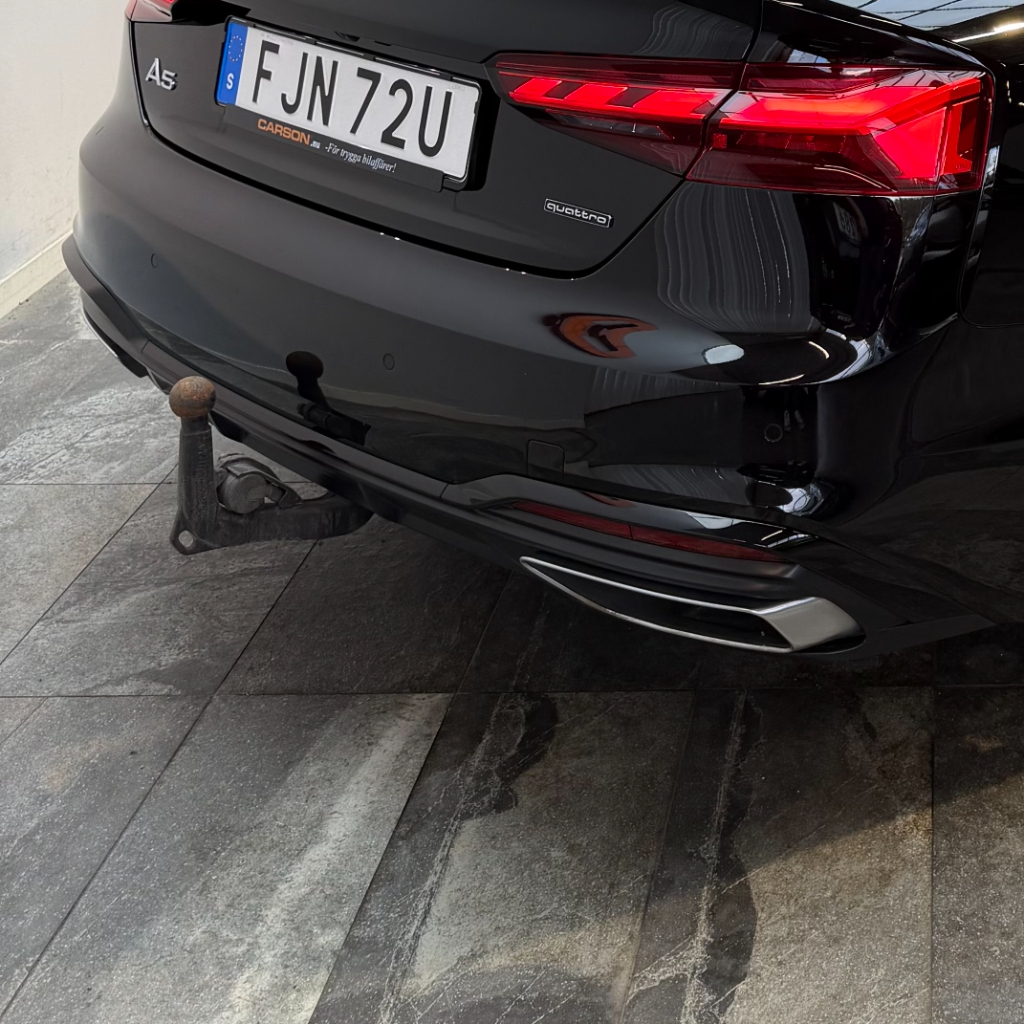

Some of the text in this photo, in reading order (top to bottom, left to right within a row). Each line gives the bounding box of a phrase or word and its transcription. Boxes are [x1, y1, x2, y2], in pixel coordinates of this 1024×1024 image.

[145, 57, 177, 91] A5
[225, 39, 453, 158] S FJN 72U
[340, 147, 361, 163] trygga
[362, 153, 397, 173] bilaffärer!
[546, 202, 607, 224] quattro
